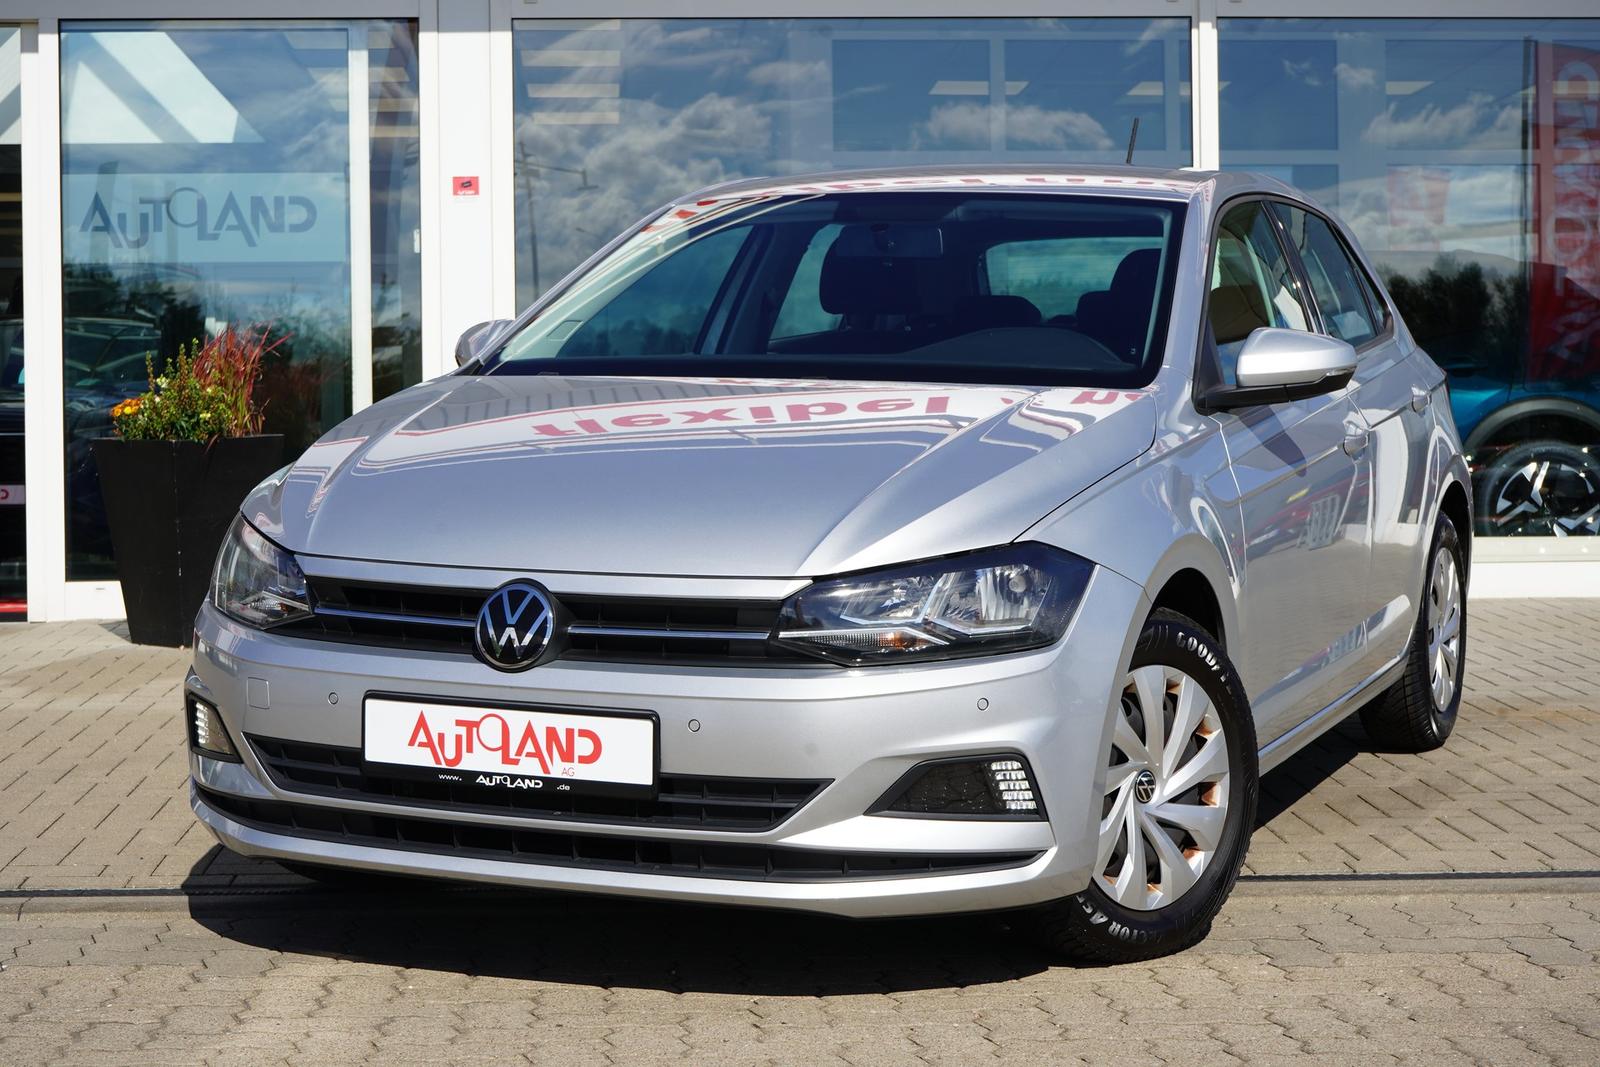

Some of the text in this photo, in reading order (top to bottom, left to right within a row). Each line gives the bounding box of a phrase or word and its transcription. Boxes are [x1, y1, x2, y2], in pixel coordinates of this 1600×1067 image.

[408, 710, 602, 774] AUTOLAND
[561, 767, 576, 777] AG
[438, 773, 462, 781] www.
[556, 783, 571, 791] .de
